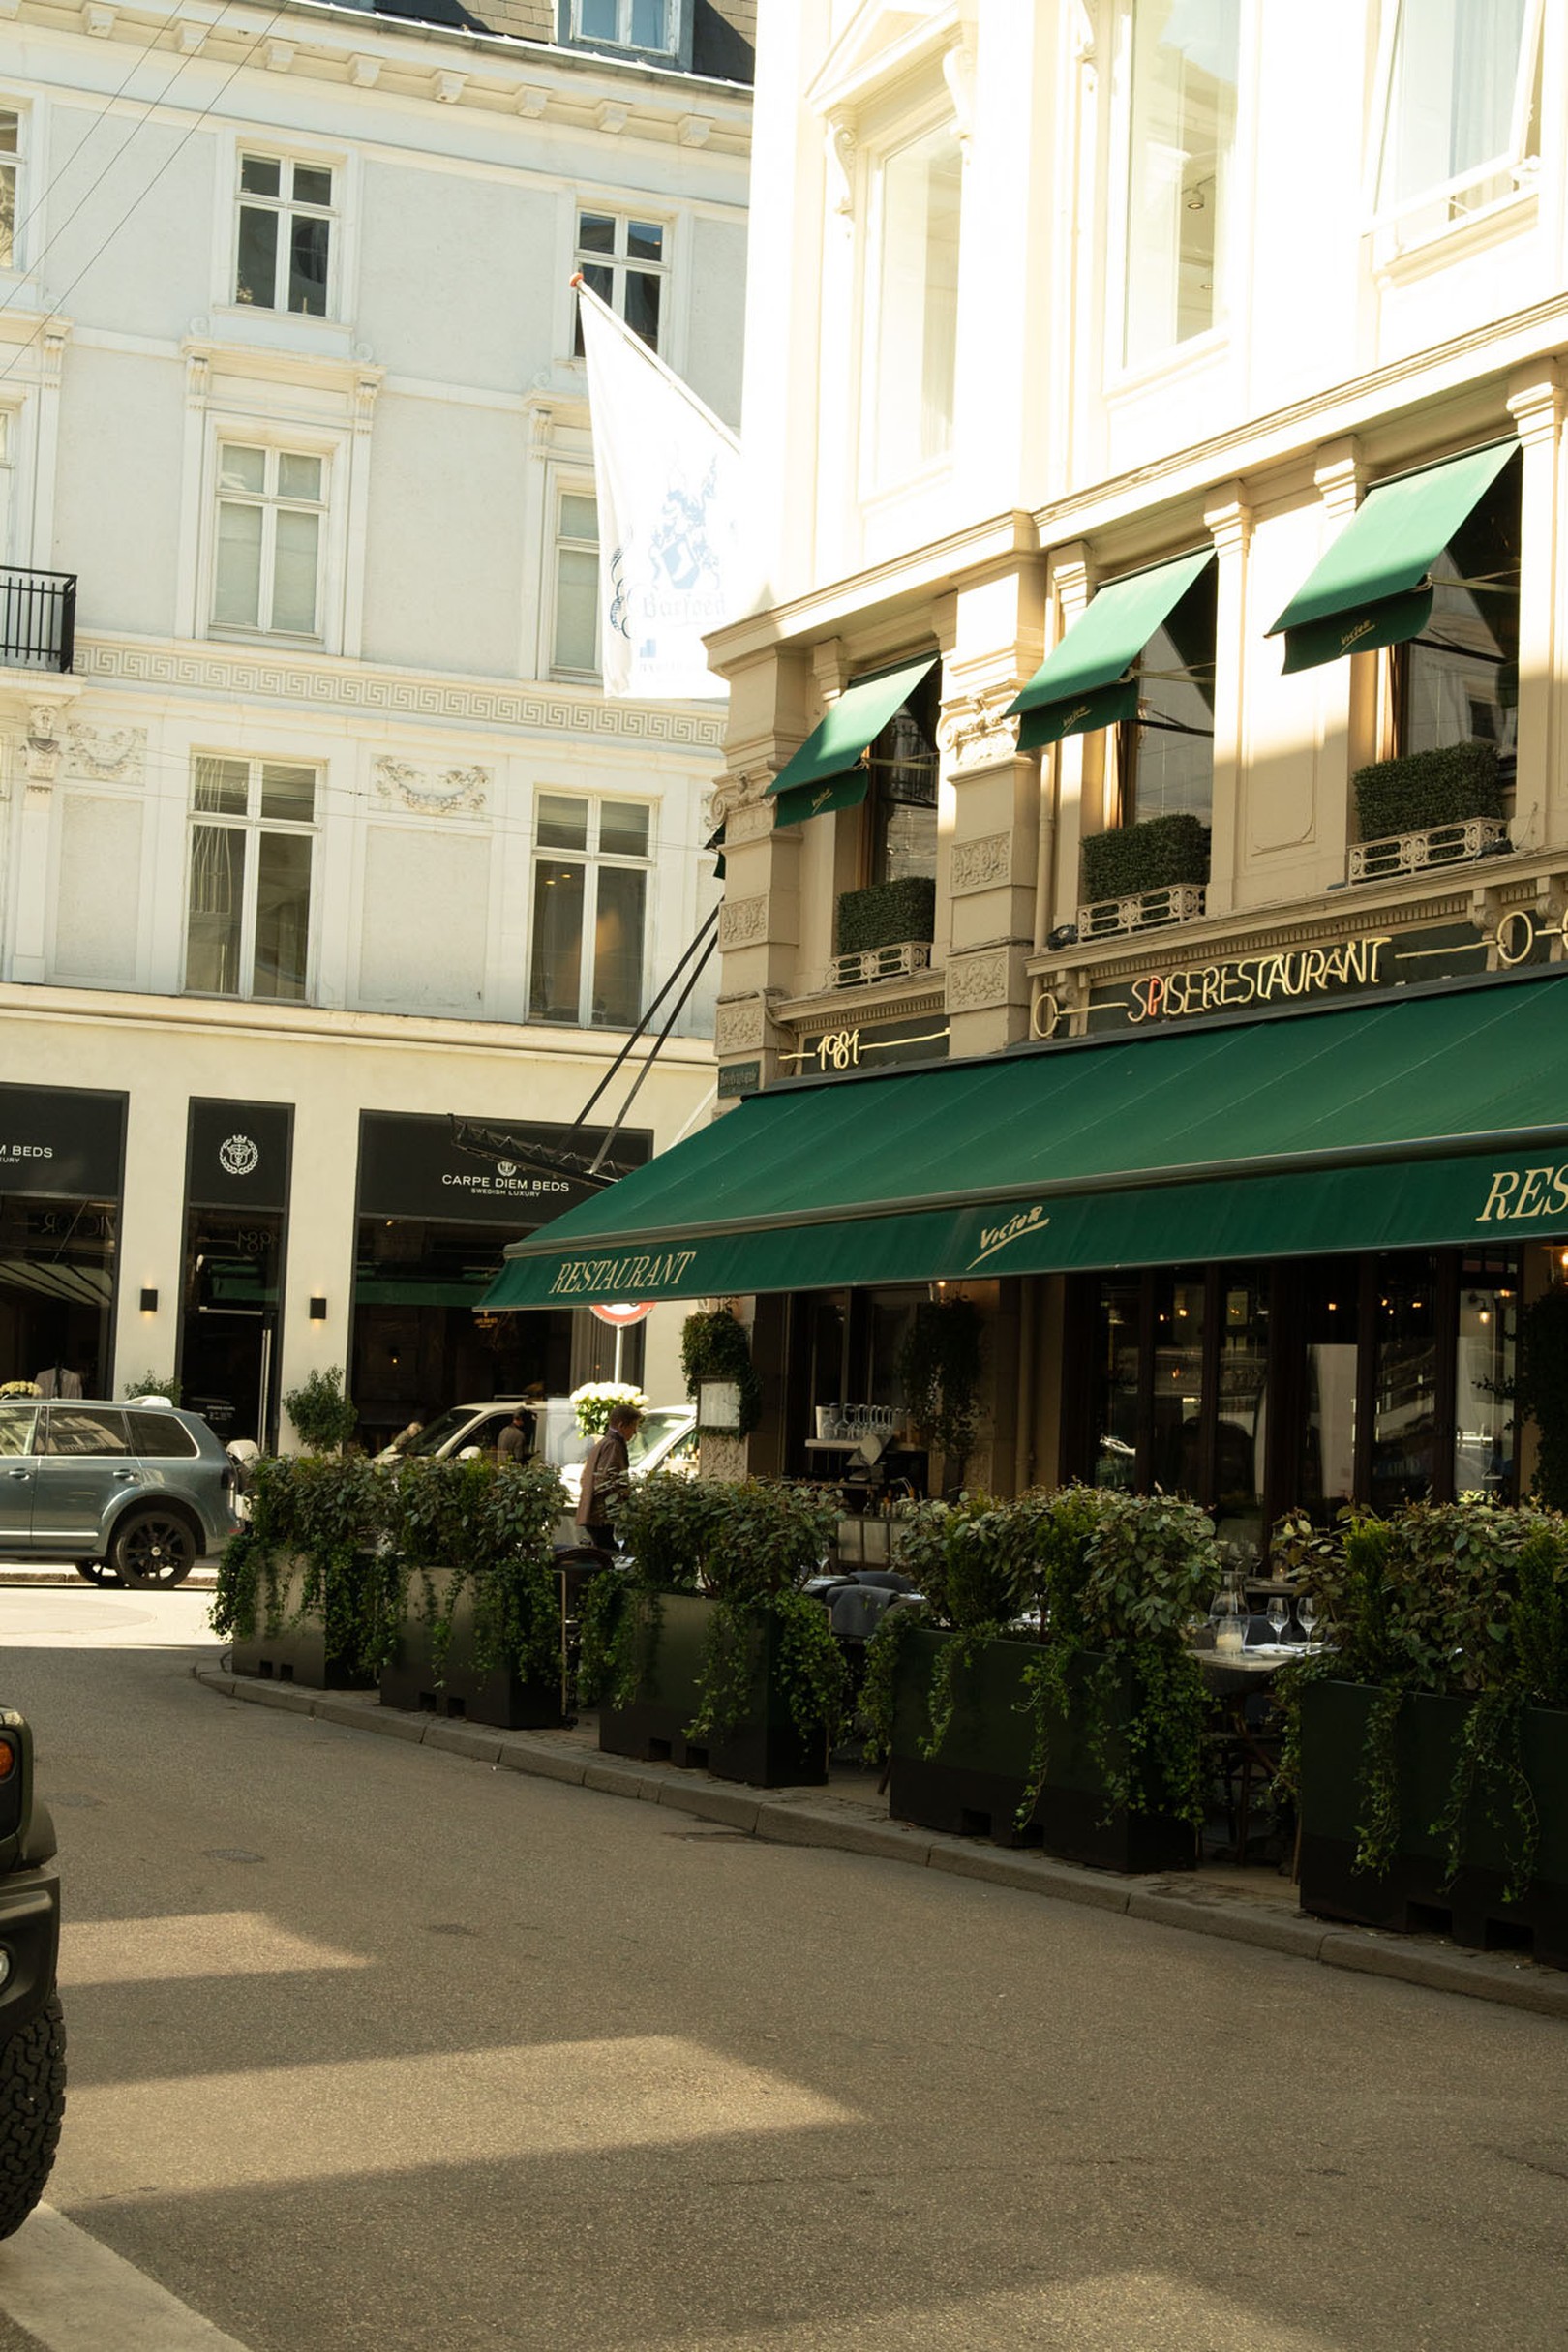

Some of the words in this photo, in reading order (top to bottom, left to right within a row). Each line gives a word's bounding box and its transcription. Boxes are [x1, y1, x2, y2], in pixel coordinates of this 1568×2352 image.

[1127, 936, 1392, 1023] SPISERESTAURANT
[816, 1028, 859, 1070] 1981
[12, 1145, 53, 1159] BEDS
[441, 1174, 491, 1188] CARPE
[495, 1178, 528, 1190] DIEM
[531, 1180, 570, 1192] BEDS
[470, 1188, 507, 1196] SWEDISH
[978, 1205, 1045, 1252] VICTOR
[548, 1251, 697, 1294] RESTAURANT
